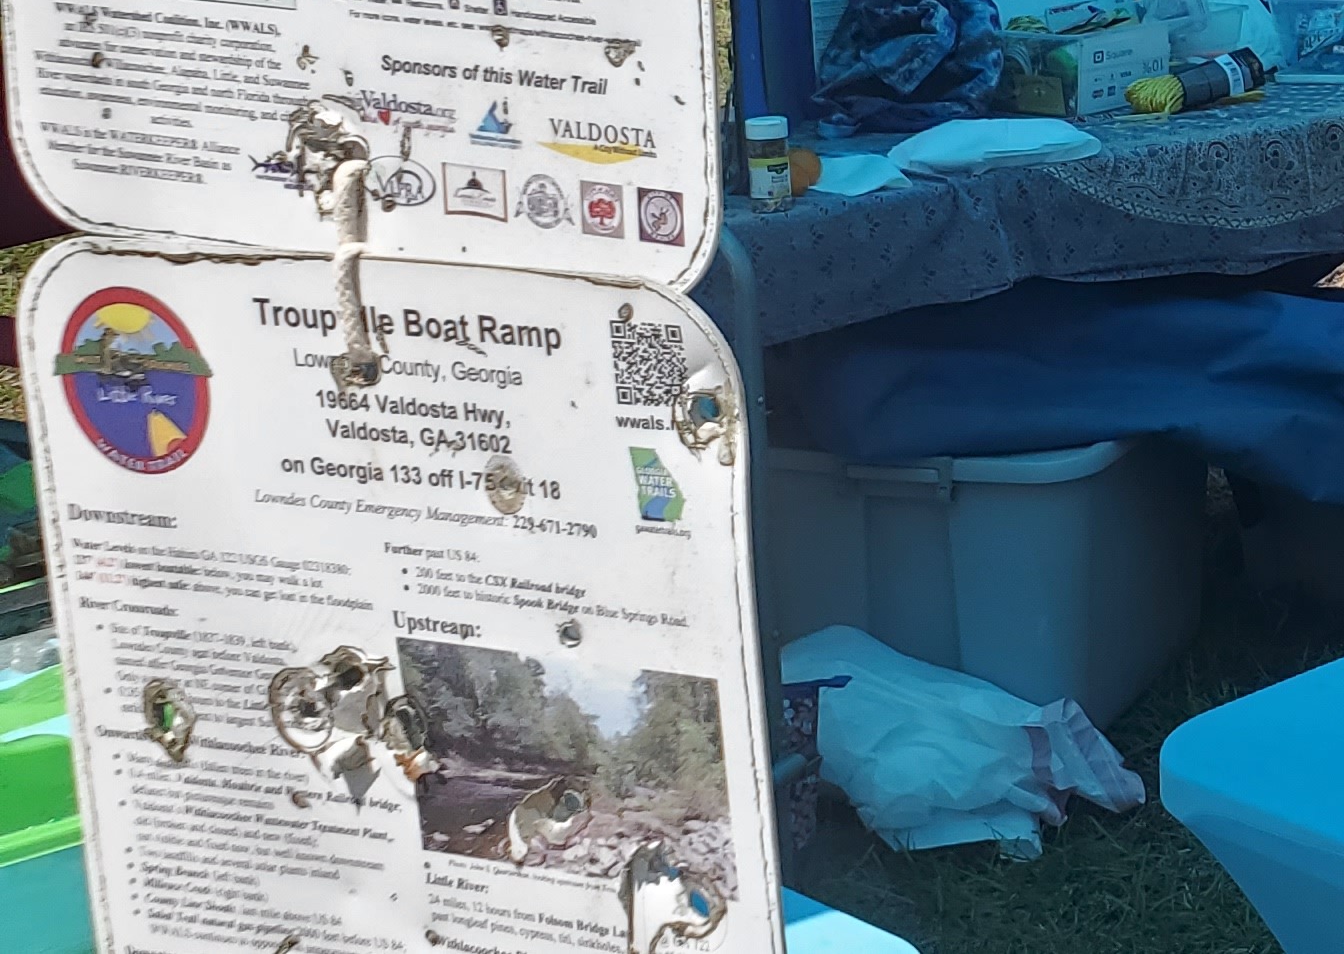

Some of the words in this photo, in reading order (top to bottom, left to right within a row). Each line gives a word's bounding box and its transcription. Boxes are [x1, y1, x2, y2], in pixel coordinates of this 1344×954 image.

[381, 54, 458, 80] Sponsors
[463, 65, 479, 81] of
[483, 66, 513, 85] this
[518, 69, 567, 91] Water
[572, 75, 608, 95] Trail
[549, 118, 657, 149] VALDOSTA
[253, 297, 394, 337] Trouplle
[402, 308, 469, 343] Boat
[478, 314, 562, 356] Ramp
[380, 354, 445, 384] County,
[451, 361, 522, 390] Georgia
[316, 390, 371, 413] 19664
[374, 394, 459, 420] Valdosta
[463, 401, 511, 428] Hwy,
[326, 419, 414, 448] Valdosta,
[456, 432, 512, 454] 31602
[281, 458, 305, 474] on
[310, 456, 384, 484] Georgia
[390, 464, 422, 484] 133
[428, 467, 453, 488] off
[540, 480, 562, 502] 18
[640, 476, 675, 488] WATER
[640, 486, 677, 498] TRAILS
[68, 503, 178, 528] Downstream:
[254, 488, 307, 507] Lowndes
[309, 494, 352, 516] County
[354, 499, 421, 521] Emergency
[393, 609, 482, 641] Upstream:
